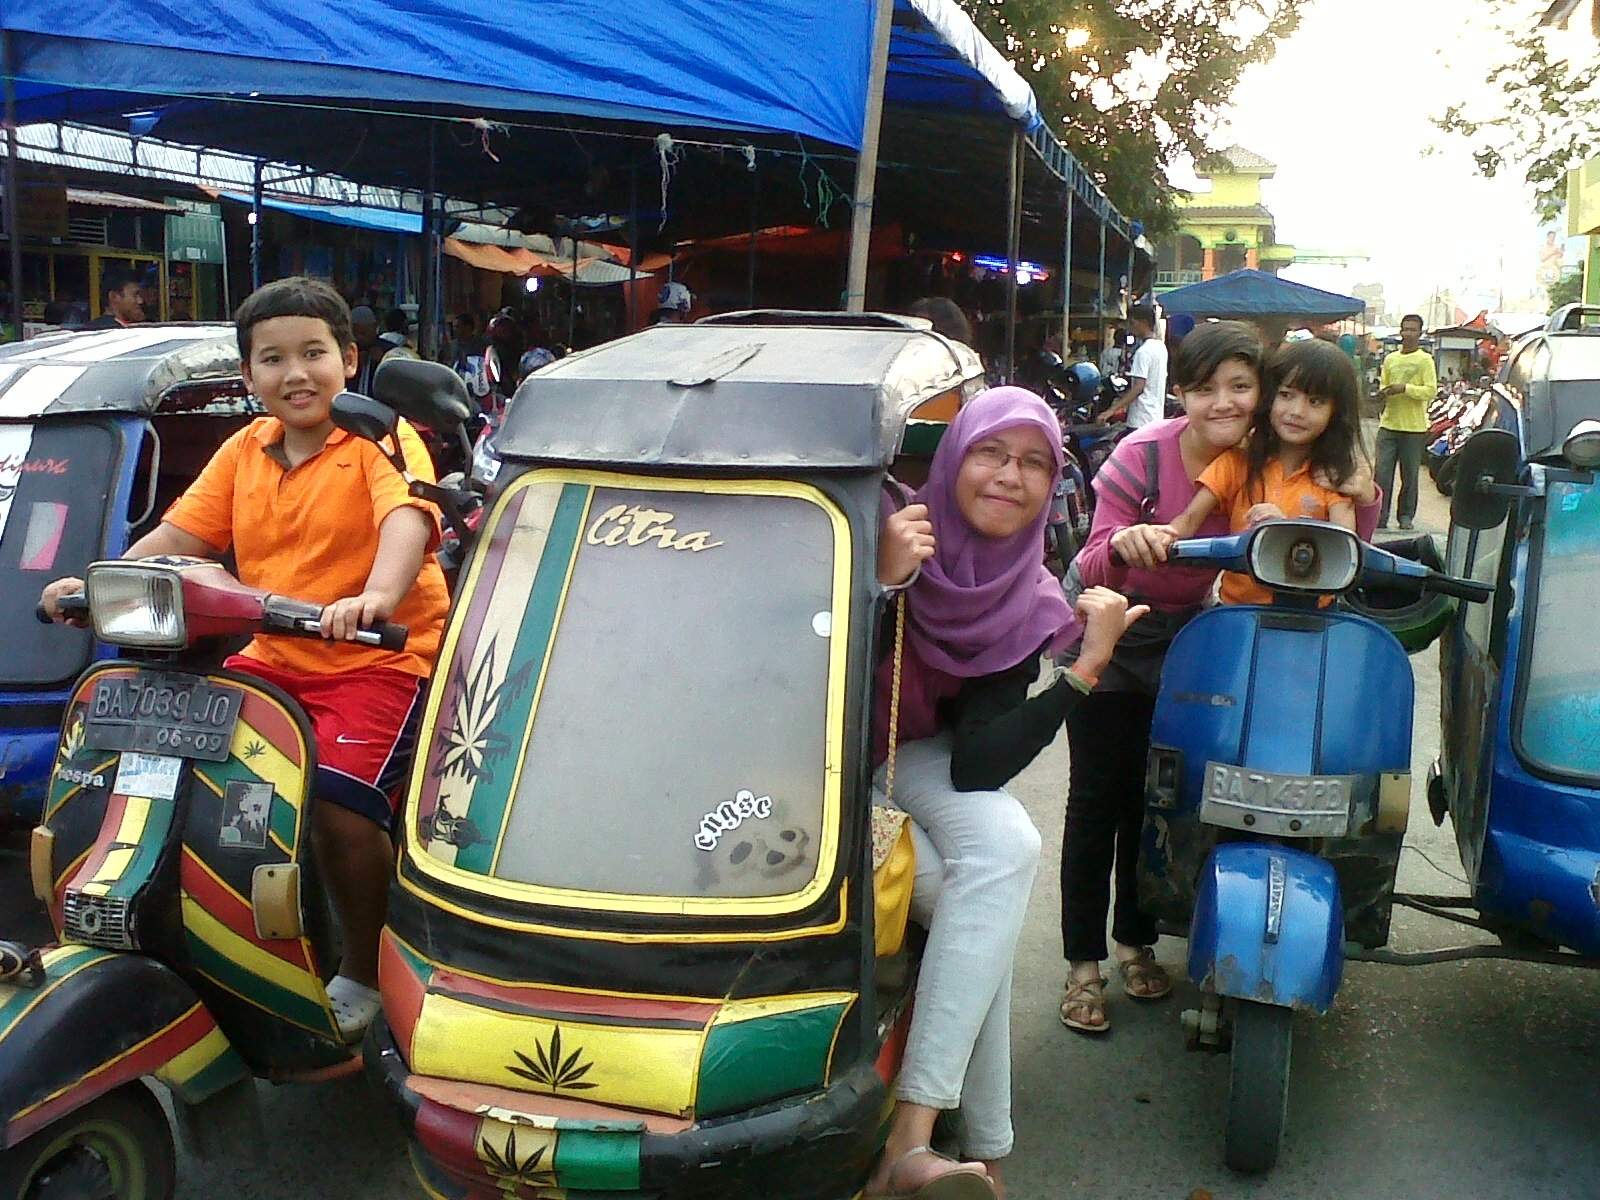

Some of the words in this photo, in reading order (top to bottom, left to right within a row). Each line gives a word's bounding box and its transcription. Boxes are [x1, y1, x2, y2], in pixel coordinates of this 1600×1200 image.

[587, 504, 726, 552] Citra
[95, 685, 123, 717] BA
[125, 685, 191, 721] 7039
[193, 693, 230, 727] JO
[1211, 766, 1244, 801] BA
